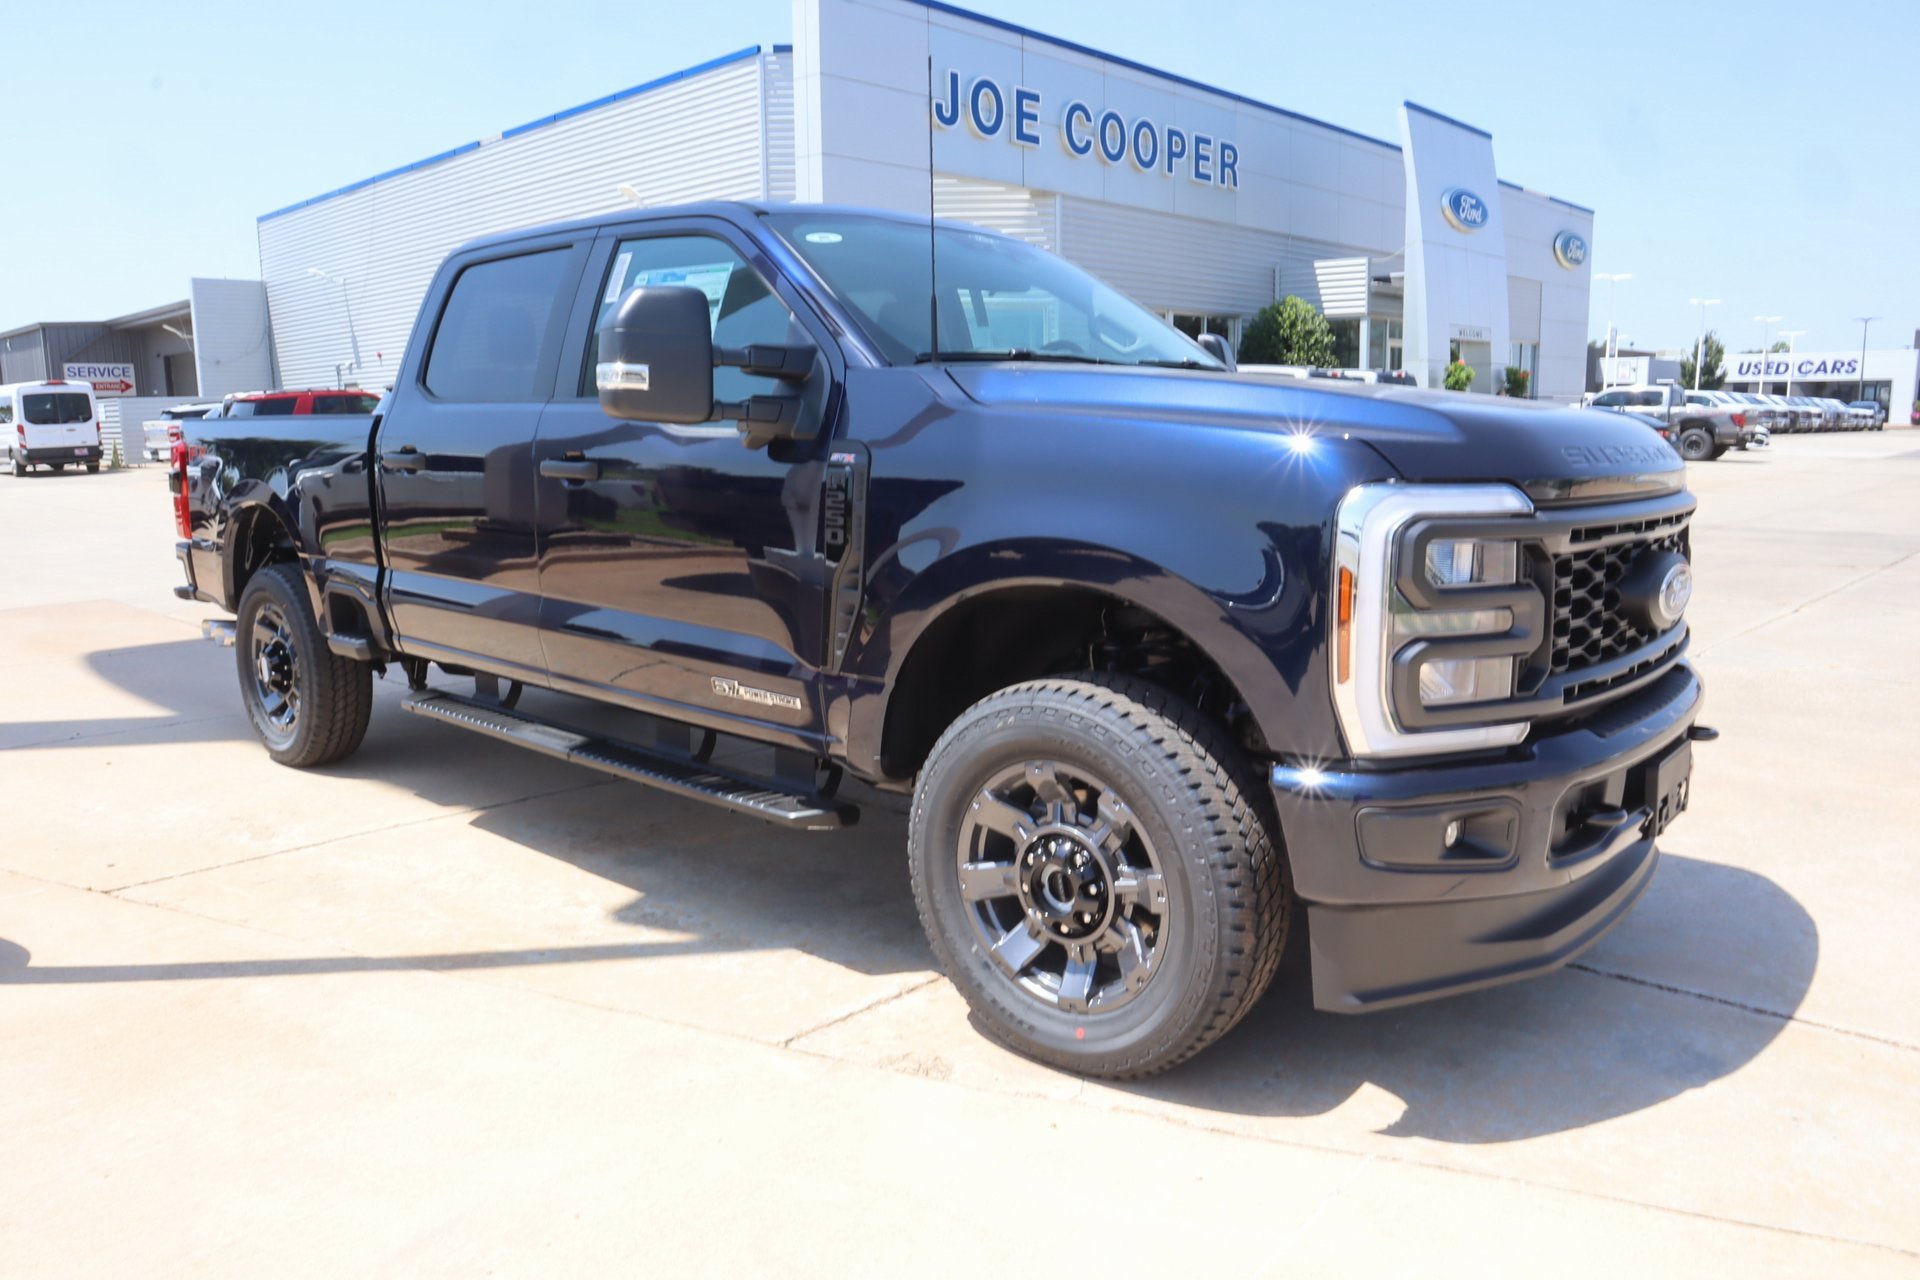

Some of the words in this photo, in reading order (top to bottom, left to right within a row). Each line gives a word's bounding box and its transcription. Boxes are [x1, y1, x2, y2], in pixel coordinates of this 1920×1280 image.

[934, 70, 1041, 146] JOE
[1063, 101, 1240, 189] COOPER
[1459, 194, 1483, 224] Ford
[1567, 237, 1585, 260] Ford
[67, 366, 131, 378] SERVICE
[1737, 360, 1790, 376] USED
[1797, 360, 1858, 375] CARS
